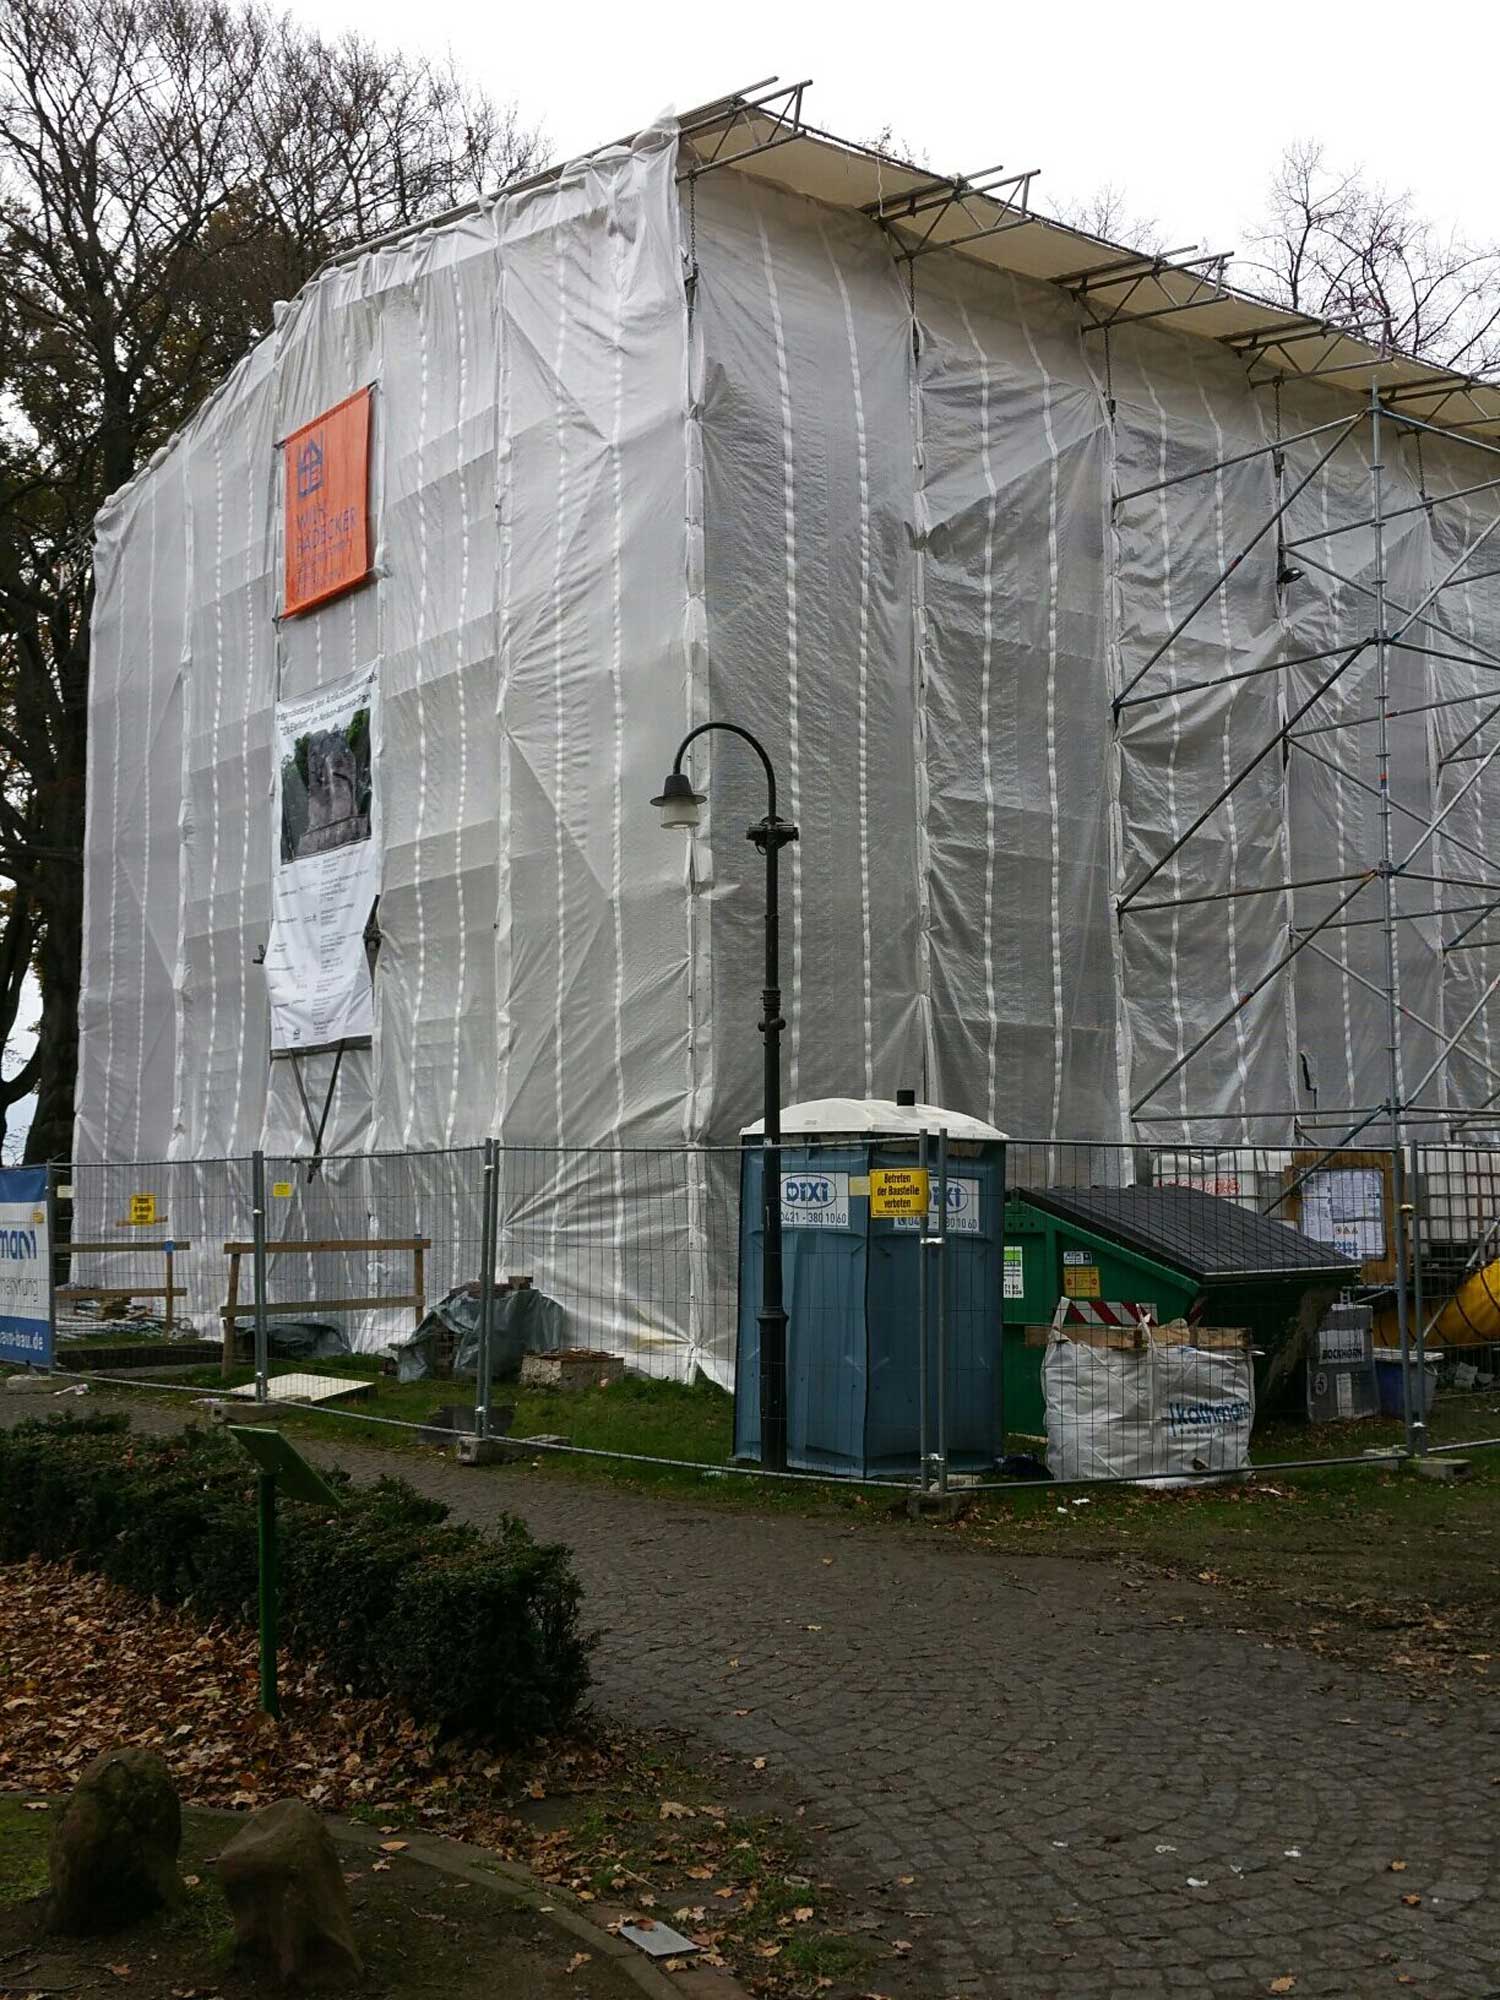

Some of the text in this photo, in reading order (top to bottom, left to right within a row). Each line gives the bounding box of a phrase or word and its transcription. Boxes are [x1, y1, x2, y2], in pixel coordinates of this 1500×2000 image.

[884, 1173, 911, 1183] Betreten
[877, 1185, 920, 1196] der Baustelle
[884, 1199, 911, 1209] verboten
[808, 1212, 823, 1224] 380
[825, 1212, 835, 1224] 10
[836, 1212, 847, 1224] 60
[1322, 1349, 1362, 1360] BOCKHORN
